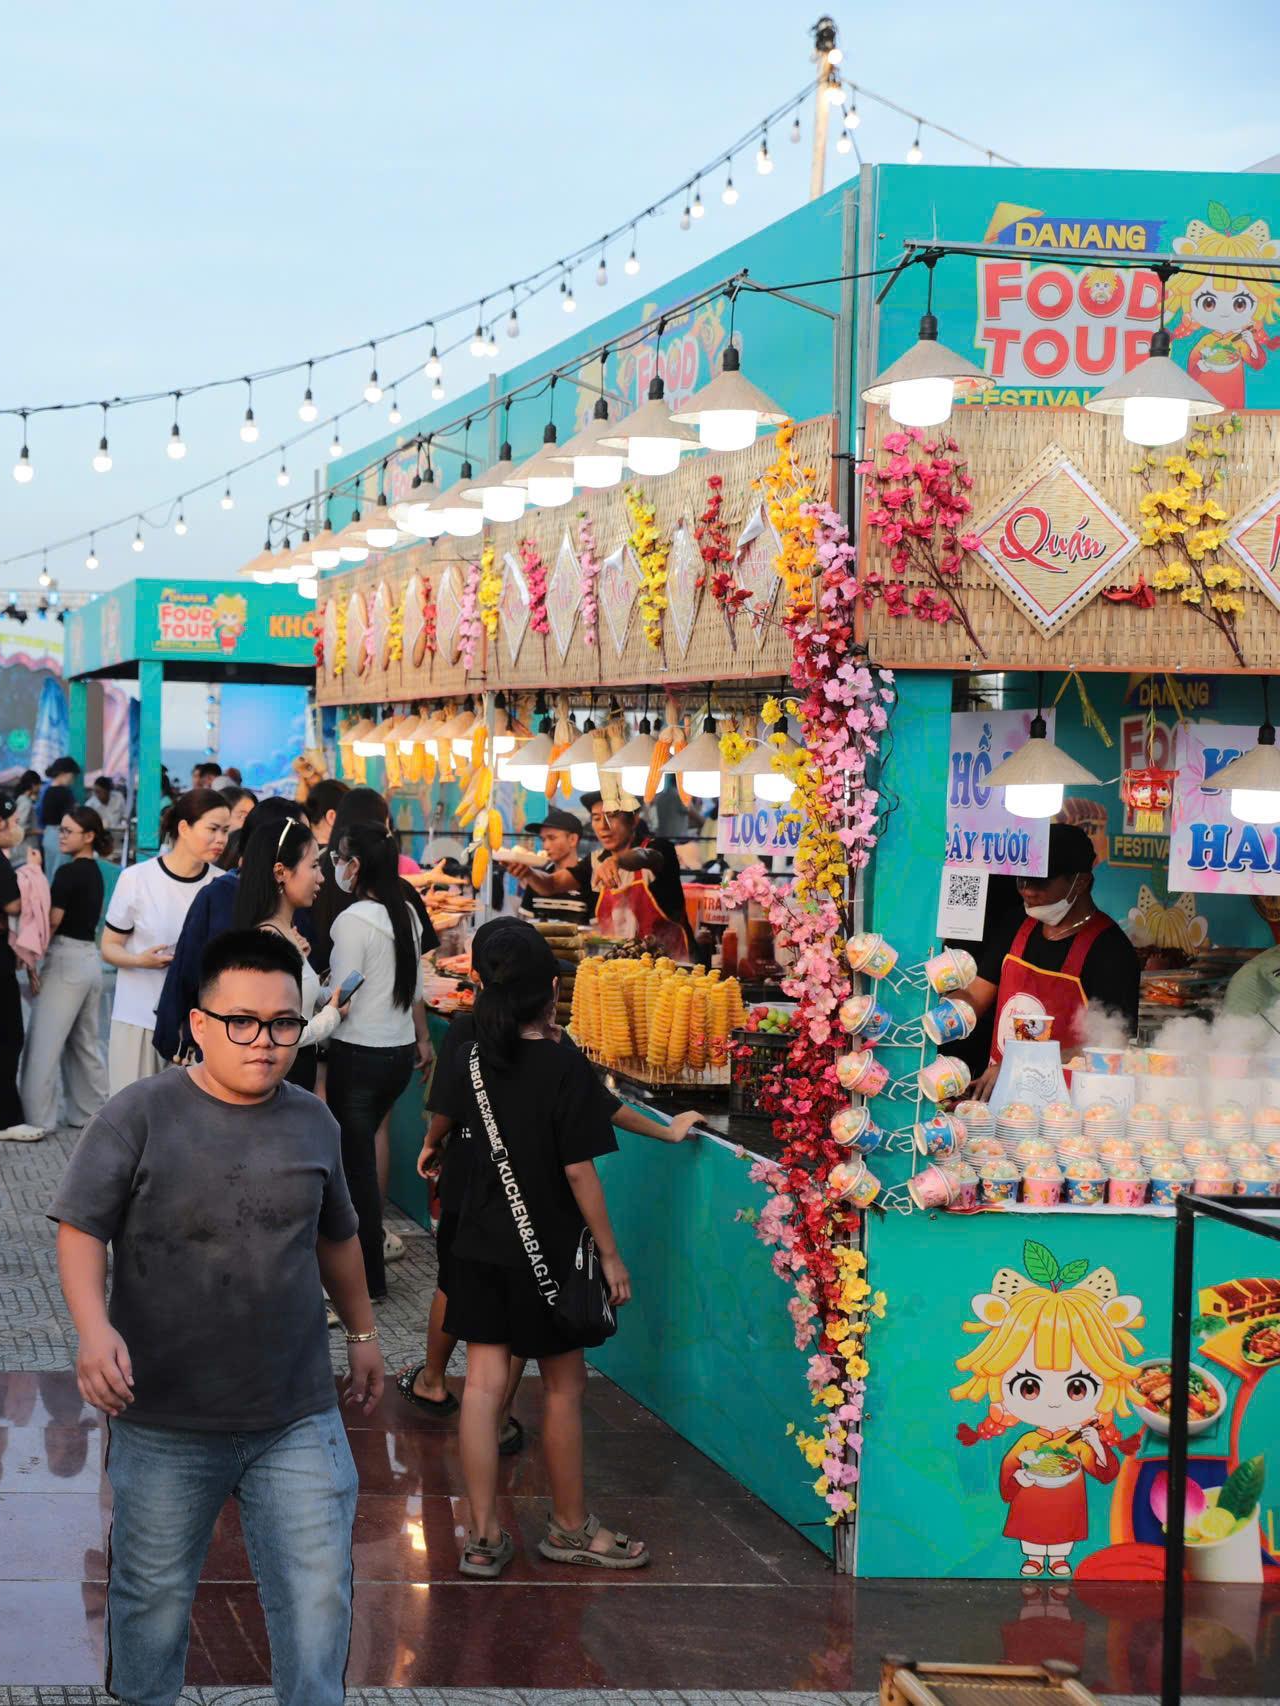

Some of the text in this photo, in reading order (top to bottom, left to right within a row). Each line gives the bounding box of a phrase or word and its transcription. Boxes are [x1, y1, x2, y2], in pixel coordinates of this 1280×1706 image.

[1015, 222, 1147, 250] DANANG
[984, 263, 1166, 320] FOOD
[999, 505, 1107, 574] Quán
[160, 605, 214, 623] FOOD
[161, 623, 212, 639] TOUR
